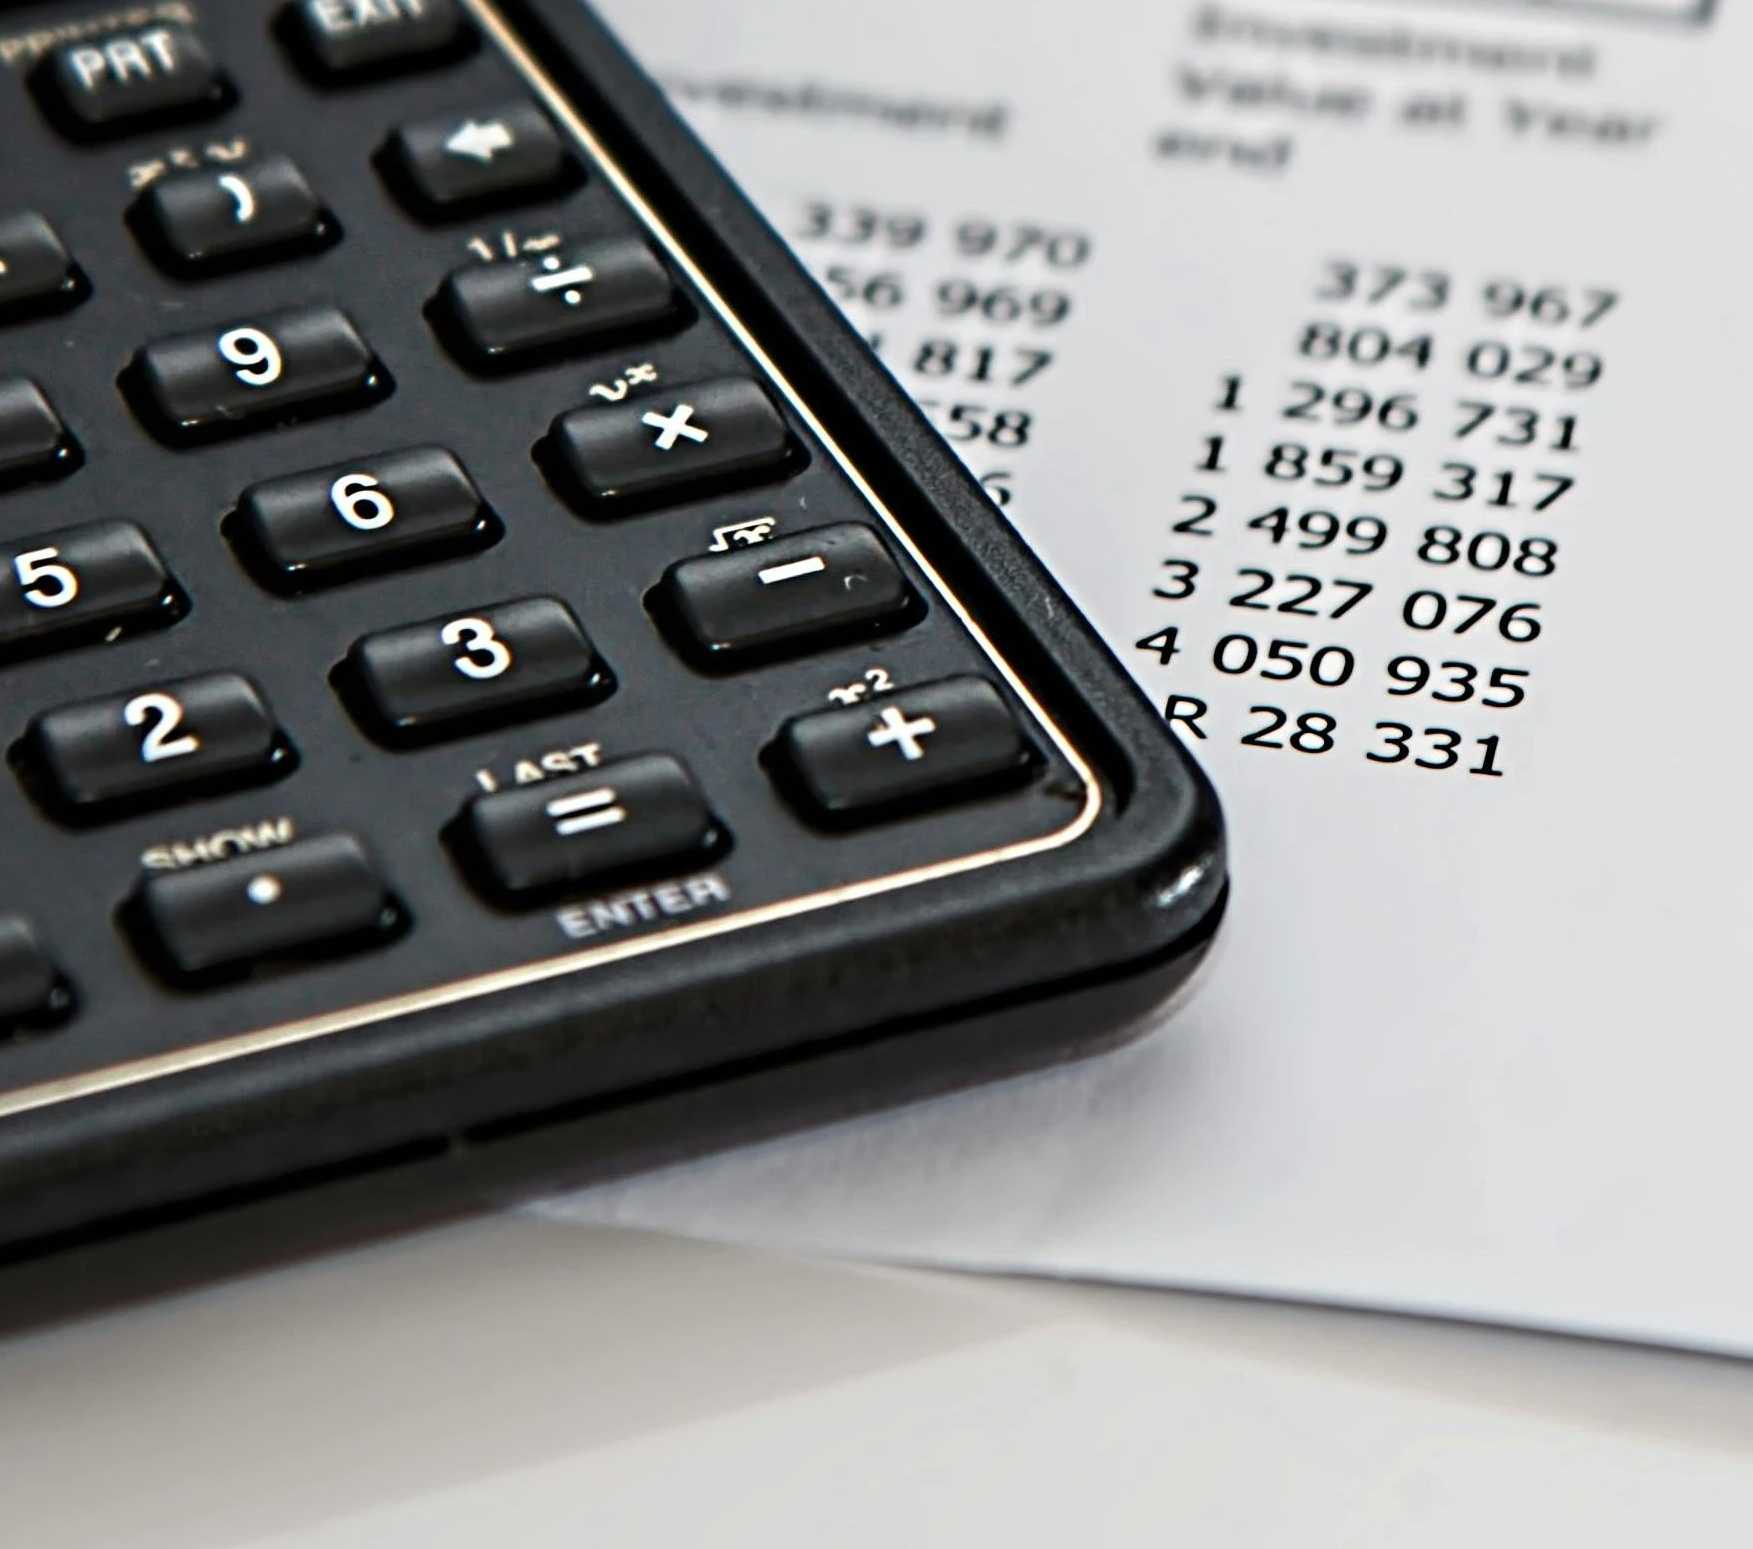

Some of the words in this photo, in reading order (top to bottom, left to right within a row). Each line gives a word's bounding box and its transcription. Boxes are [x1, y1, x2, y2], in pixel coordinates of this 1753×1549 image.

[69, 31, 178, 90] PRT
[802, 202, 929, 248] 339
[954, 219, 1093, 268] 970
[936, 278, 1071, 327] 969
[1316, 260, 1450, 312] 373
[1482, 280, 1620, 328] 967
[217, 326, 283, 386] 9
[912, 339, 1052, 387] 817
[1298, 321, 1436, 371] 804
[1465, 341, 1605, 390] 029
[1213, 374, 1243, 413] 1
[1281, 381, 1421, 432] 296
[1451, 401, 1579, 452] 731
[331, 472, 396, 531] 6
[1195, 434, 1226, 473] 1
[1264, 442, 1405, 492] 859
[1433, 462, 1575, 512] 317
[1172, 495, 1219, 537] 2
[1247, 506, 1389, 555] 499
[1417, 524, 1559, 578] 808
[13, 546, 78, 608] 5
[1152, 560, 1200, 600] 3
[1228, 568, 1375, 620] 227
[1403, 589, 1543, 644] 076
[439, 616, 512, 681] 3
[1134, 626, 1181, 665] 4
[1211, 633, 1356, 688] 050
[1386, 655, 1531, 709] 935
[123, 692, 201, 762] 2
[1164, 694, 1210, 740] R
[1240, 705, 1338, 754] 28
[1366, 721, 1504, 779] 331
[553, 872, 733, 941] ENTER
